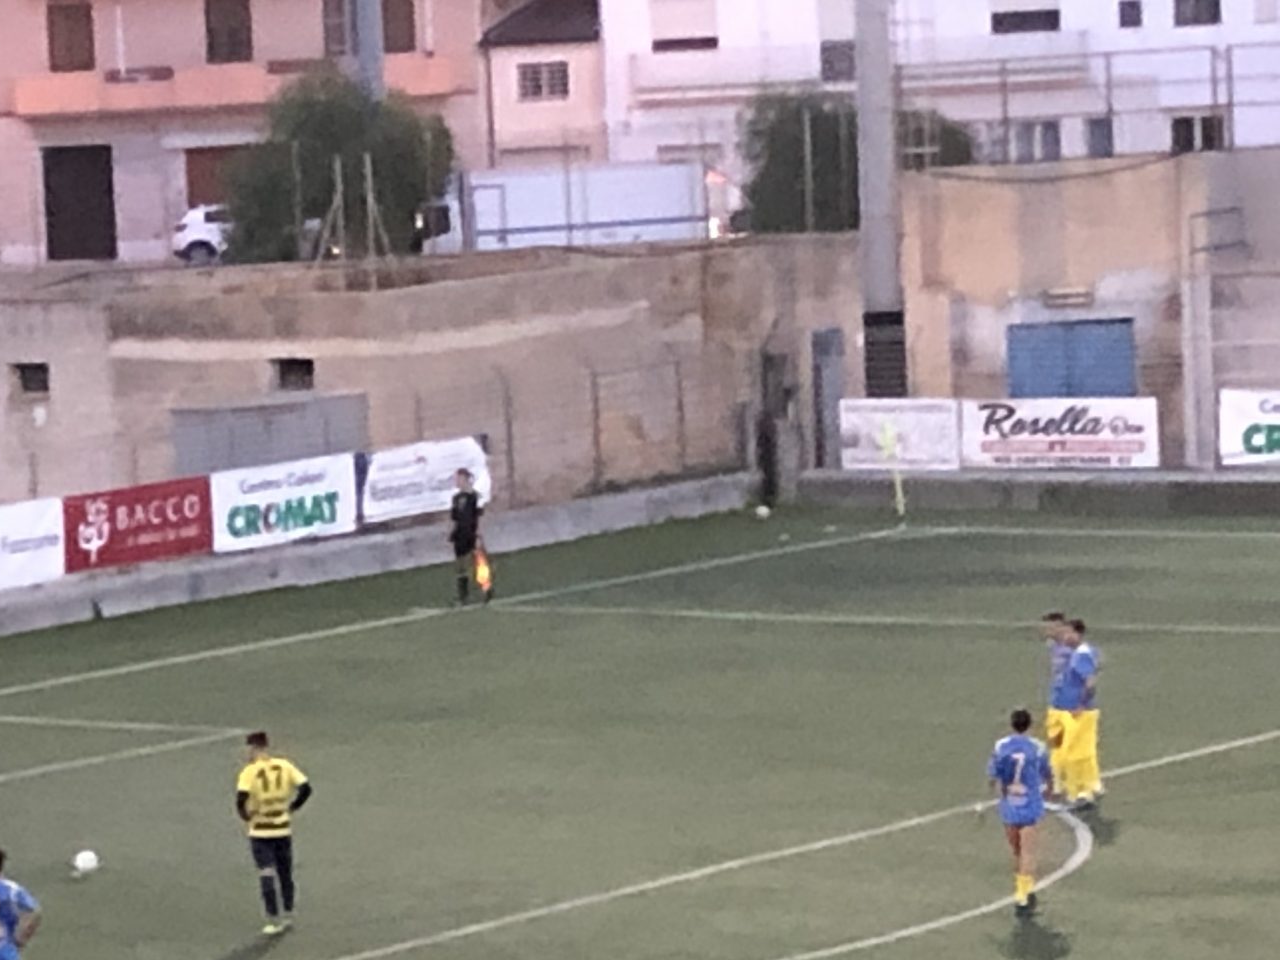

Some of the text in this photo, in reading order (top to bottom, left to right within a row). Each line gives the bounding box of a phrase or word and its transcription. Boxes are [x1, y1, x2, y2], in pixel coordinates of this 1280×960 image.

[978, 403, 1105, 438] Rosella
[116, 494, 200, 530] BACCO
[226, 490, 339, 538] CROMAT
